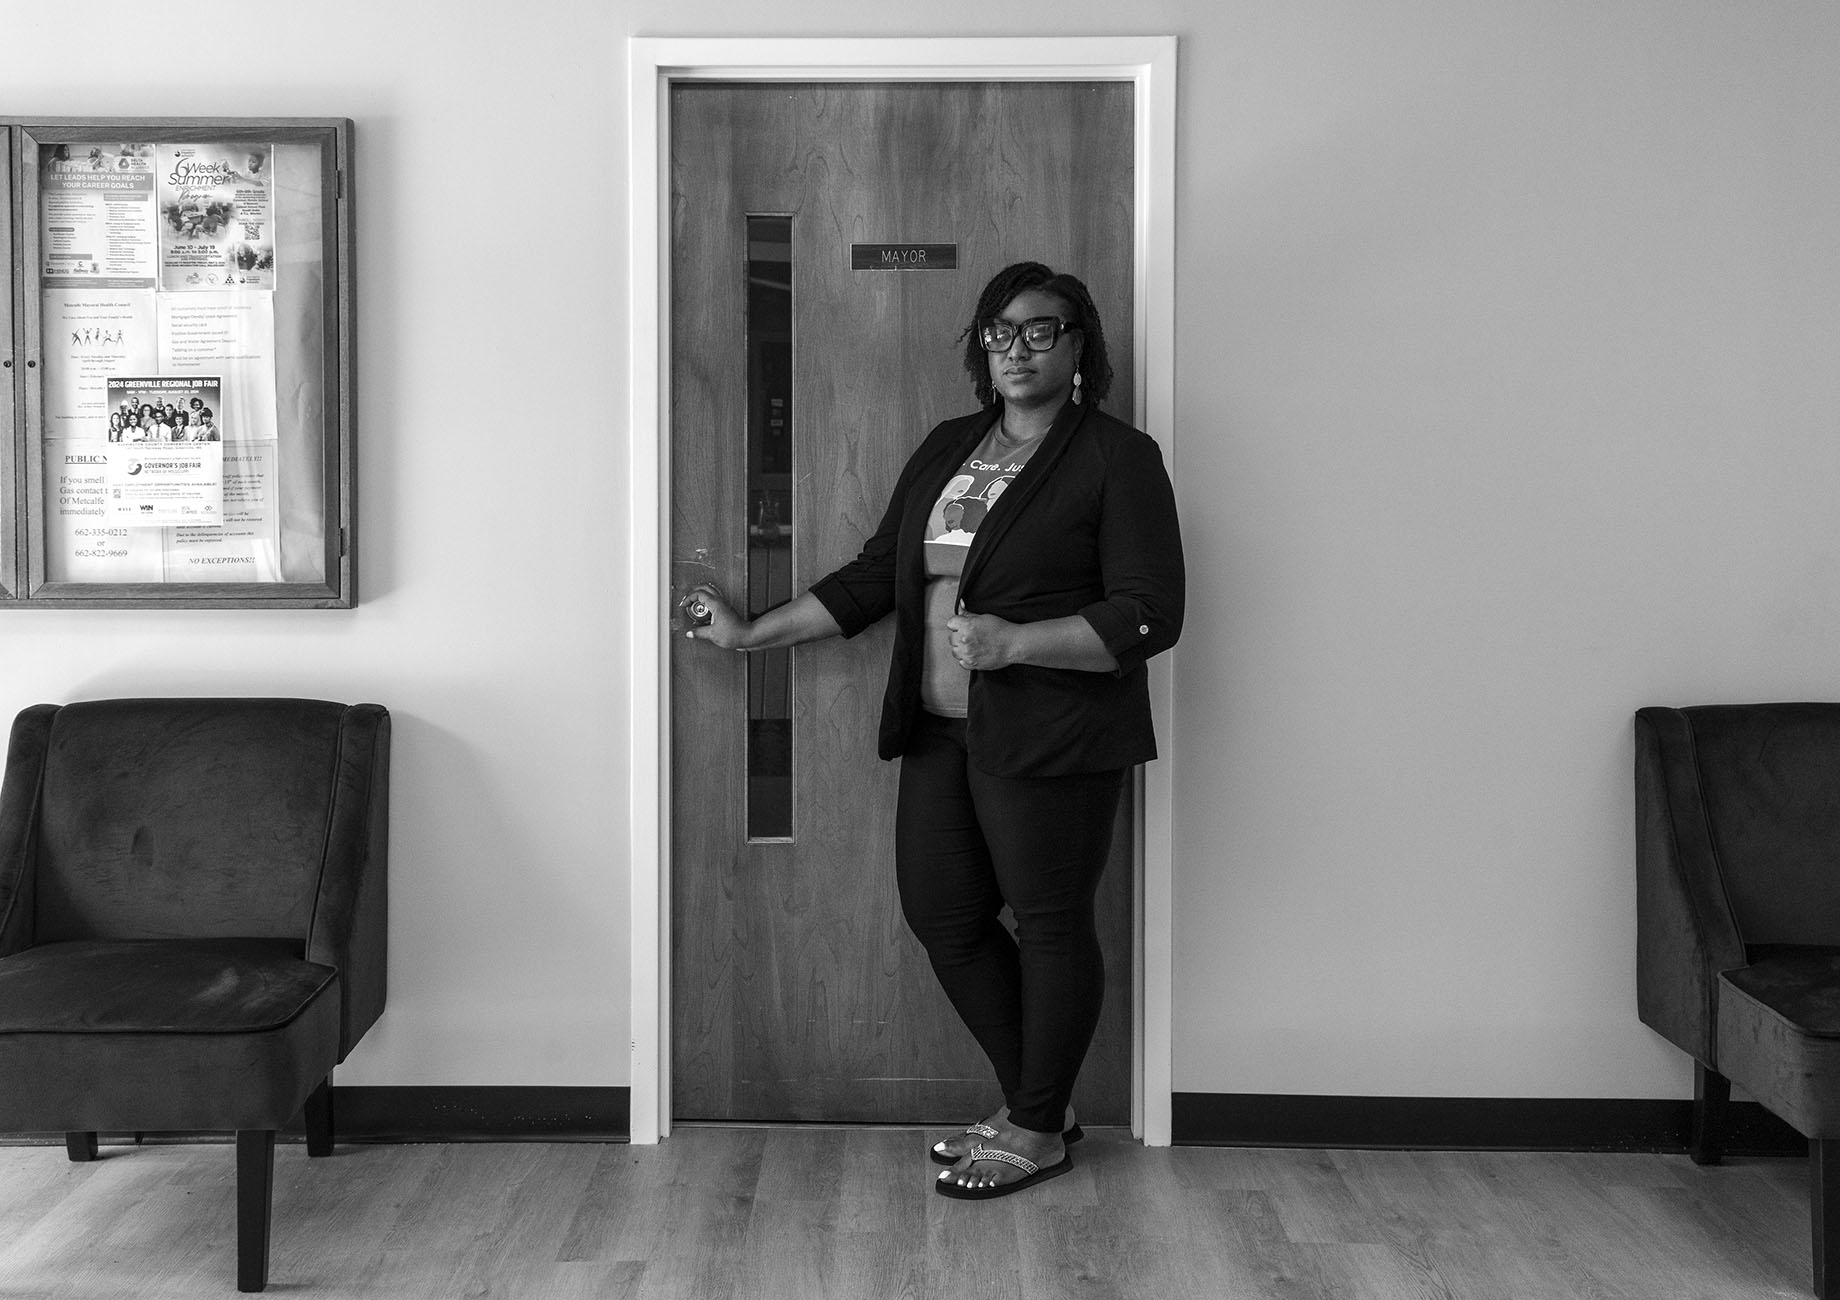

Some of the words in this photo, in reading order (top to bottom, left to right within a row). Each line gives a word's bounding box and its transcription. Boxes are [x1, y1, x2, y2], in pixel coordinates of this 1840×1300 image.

[188, 162, 220, 174] Week
[168, 173, 229, 185] Summer
[882, 250, 926, 263] MAYOR
[125, 380, 160, 388] GREENVILLE
[162, 380, 191, 388] REGIONAL
[192, 380, 203, 388] JOB
[970, 460, 1001, 471] Care.
[60, 507, 105, 517] immediately
